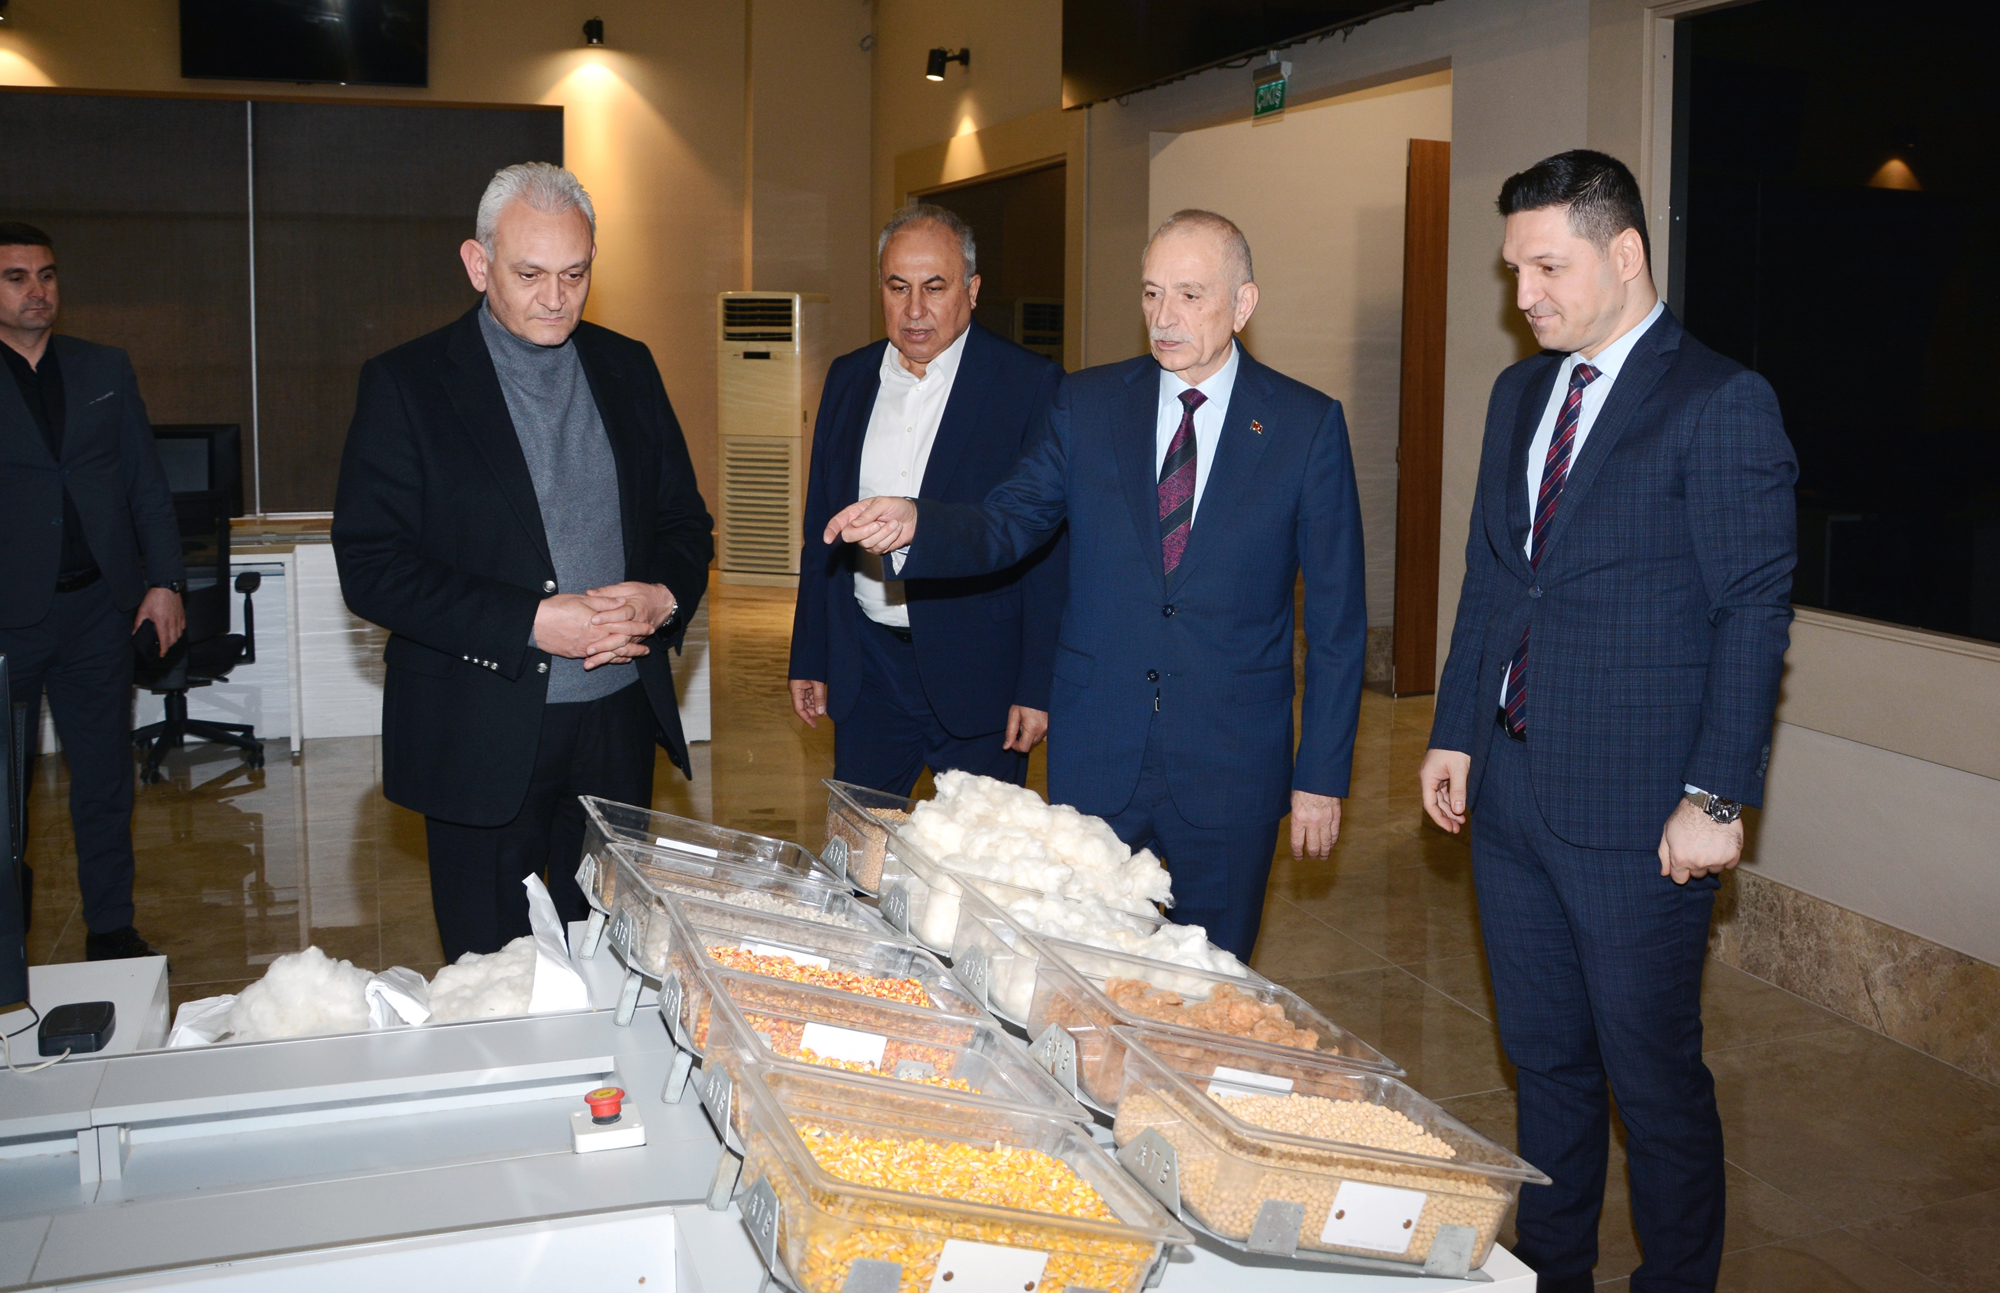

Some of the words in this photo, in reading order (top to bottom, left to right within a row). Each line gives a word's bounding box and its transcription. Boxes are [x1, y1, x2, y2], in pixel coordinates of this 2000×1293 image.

[1257, 84, 1282, 113] ÇIKIŞ
[706, 1074, 727, 1114] ATB
[1135, 1141, 1170, 1185] ATB
[748, 1193, 773, 1238] ATB
